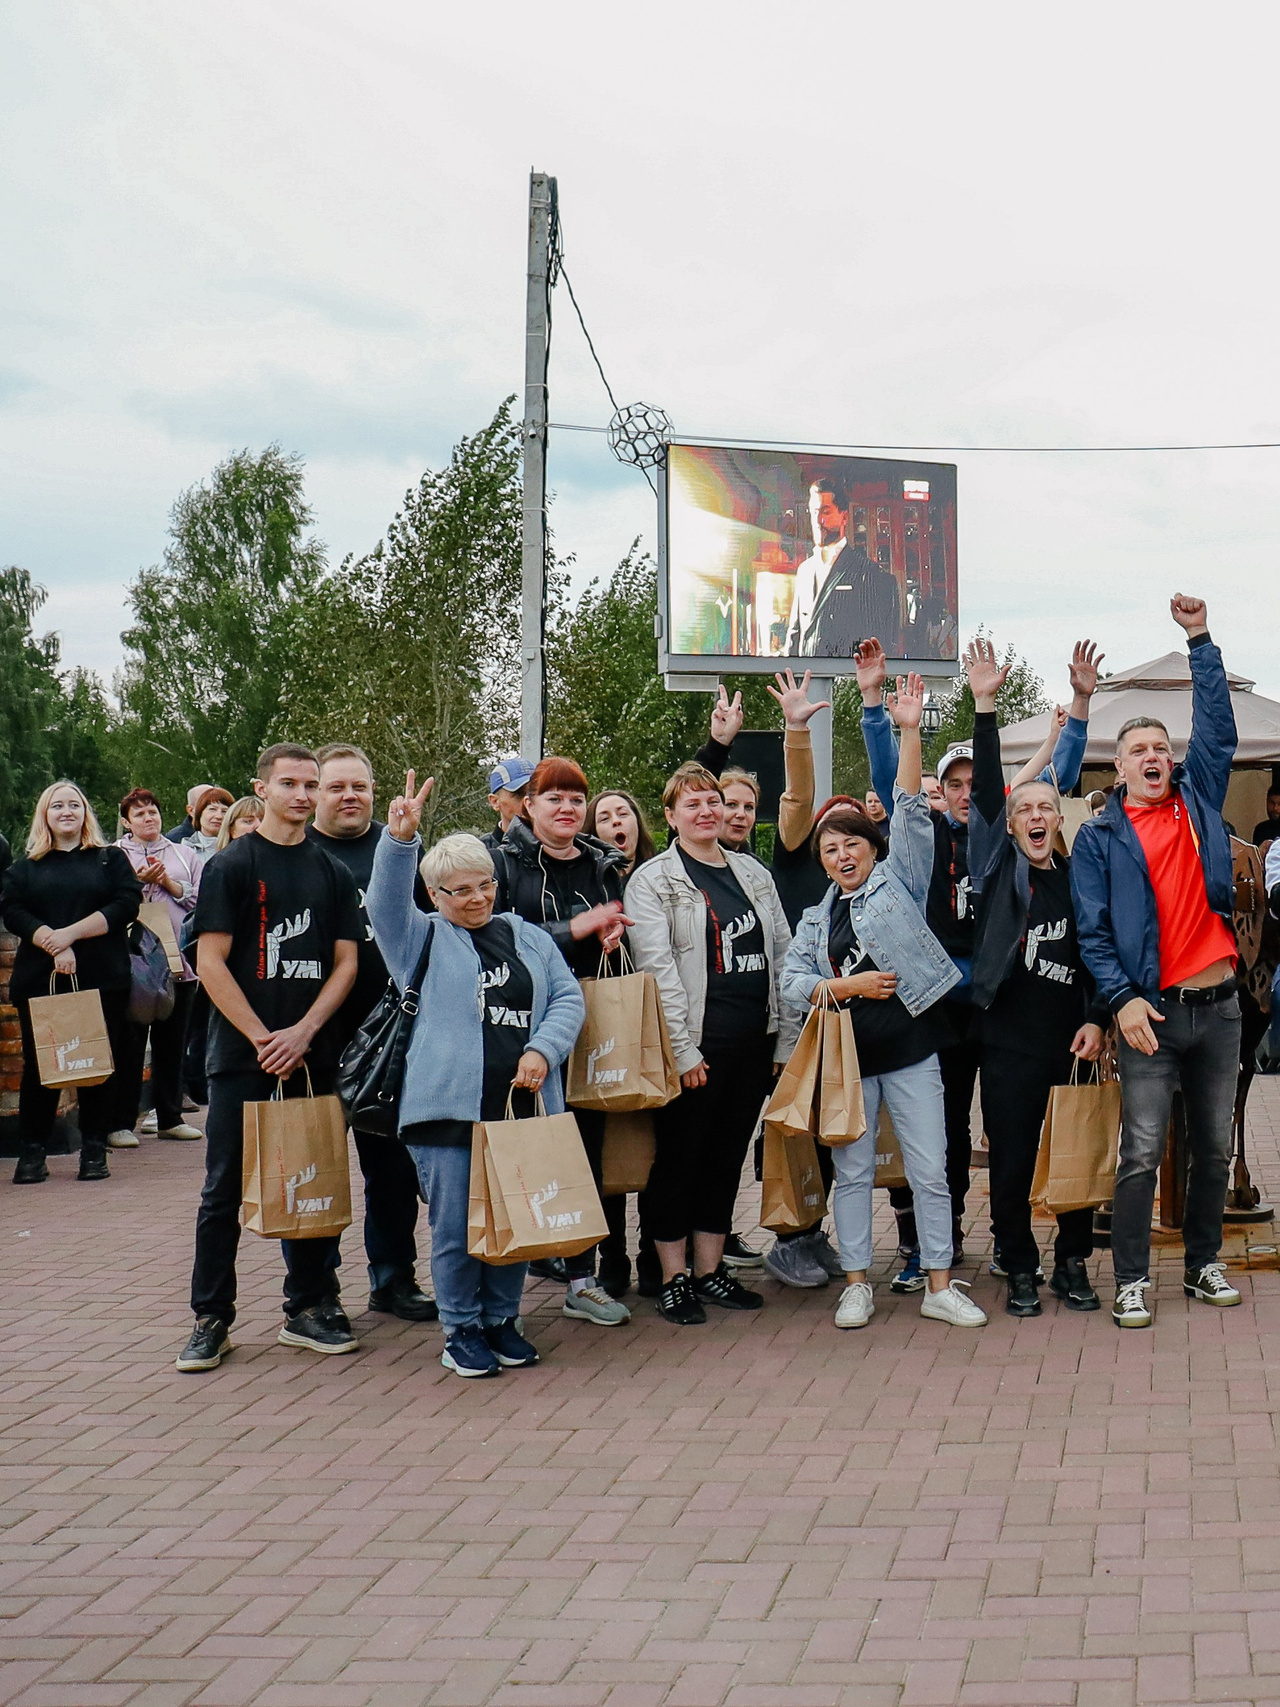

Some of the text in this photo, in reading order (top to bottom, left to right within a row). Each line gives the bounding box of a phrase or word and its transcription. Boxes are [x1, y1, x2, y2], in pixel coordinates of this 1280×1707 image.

[281, 960, 322, 980] УМ
[67, 1057, 95, 1071] УМТ
[595, 1068, 628, 1084] УМТ
[296, 1196, 334, 1213] УМТ
[546, 1210, 583, 1229] УМТ
